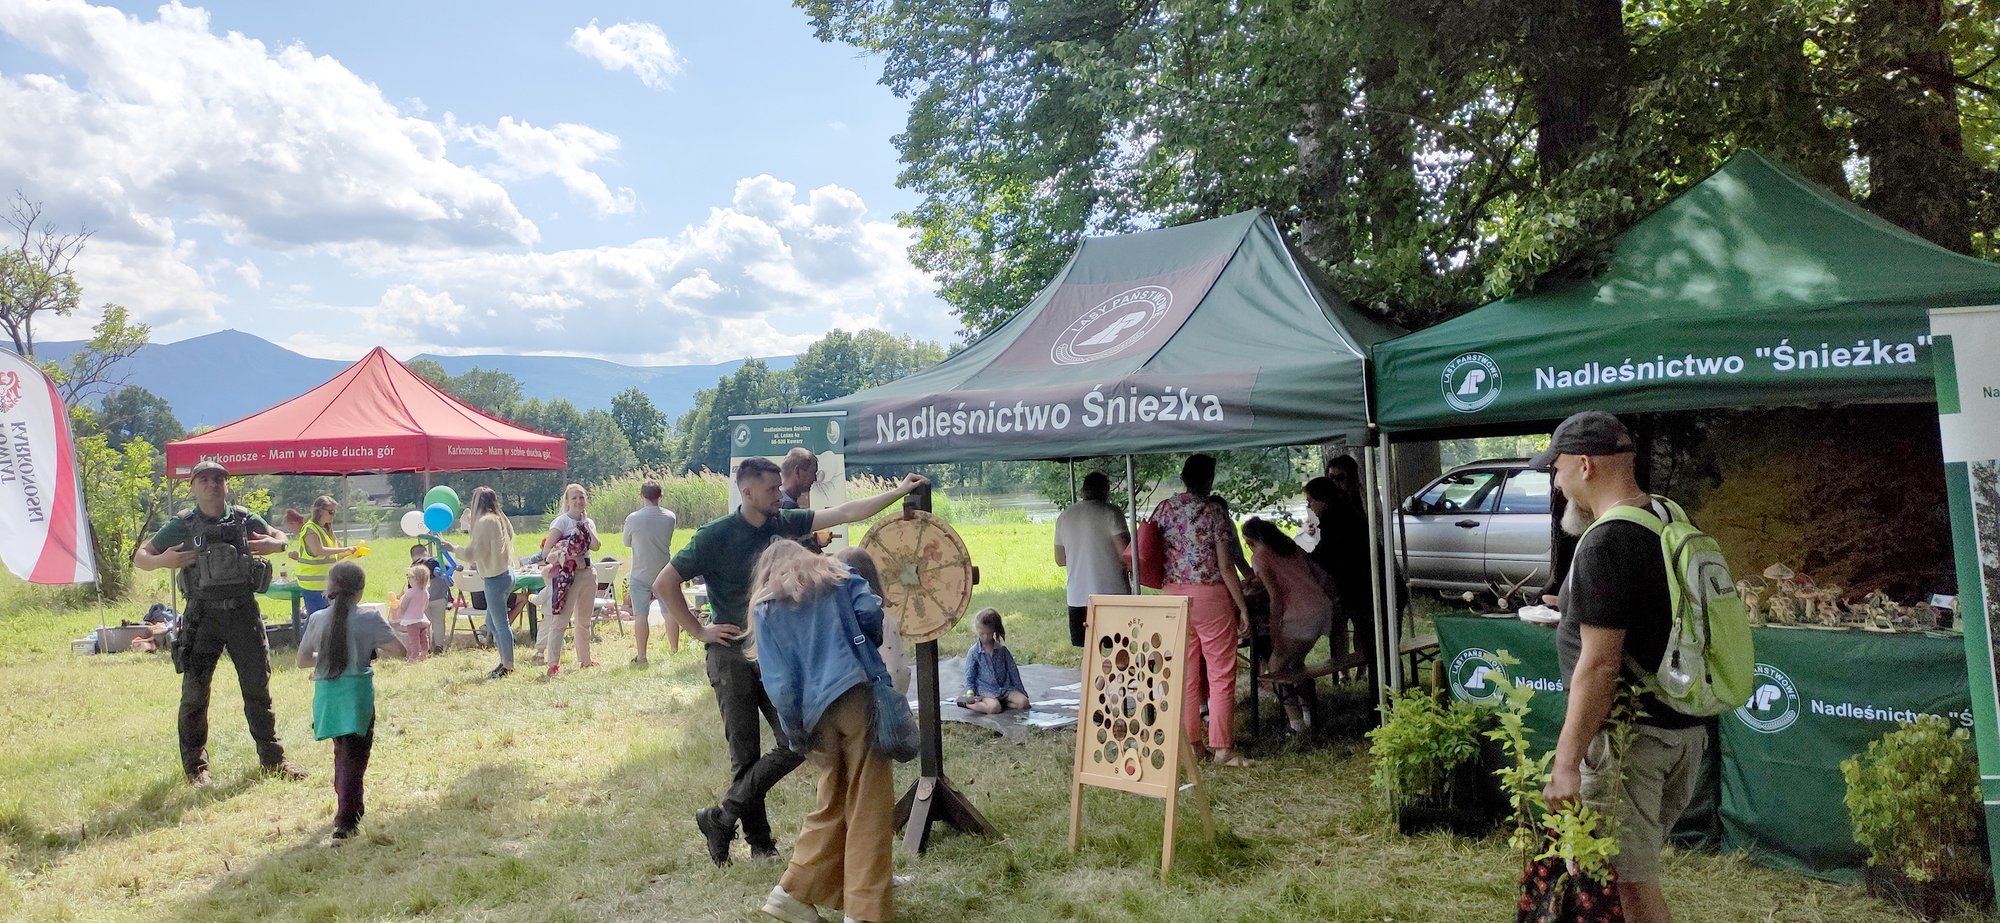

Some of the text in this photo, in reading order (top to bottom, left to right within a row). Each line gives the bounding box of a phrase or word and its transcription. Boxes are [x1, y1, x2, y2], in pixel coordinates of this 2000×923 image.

[1072, 289, 1167, 332] LASY PAŃSTWOWE
[1444, 354, 1499, 383] LASY PAŃSTWOWE
[1535, 335, 1933, 390] Nadleśnictwo "Śnieżka"
[876, 383, 1224, 444] Nadleśnictwo Śnieżka
[200, 453, 258, 463] Karkonosze
[269, 450, 294, 460] Mam
[298, 450, 307, 458] w
[310, 446, 339, 458] sobie
[342, 446, 374, 457] ducha
[377, 445, 395, 459] gór
[447, 445, 483, 456] Karkonosze
[488, 446, 503, 455] Mam
[504, 448, 510, 456] w
[1128, 618, 1143, 628] META
[1515, 676, 1564, 691] Nadleś
